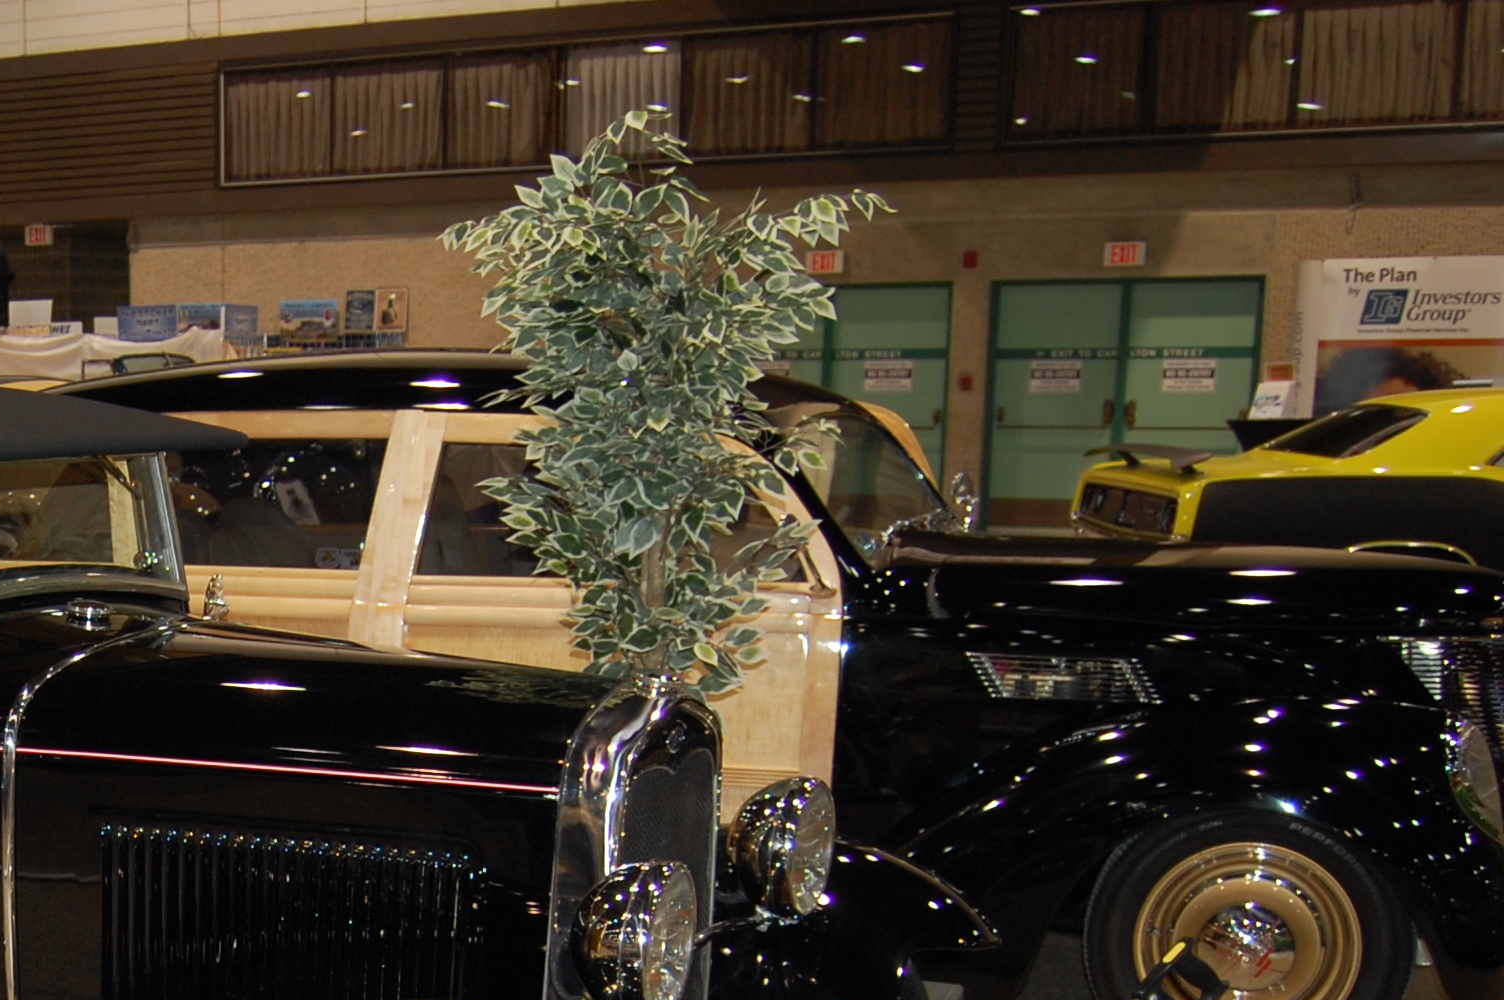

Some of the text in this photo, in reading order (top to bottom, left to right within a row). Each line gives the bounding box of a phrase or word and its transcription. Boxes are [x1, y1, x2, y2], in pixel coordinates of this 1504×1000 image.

[812, 252, 837, 272] EXIT
[1111, 243, 1139, 265] EXIT
[1342, 266, 1417, 283] The Plan
[1348, 287, 1361, 298] by
[1411, 287, 1502, 307] Investors
[1406, 305, 1468, 325] Group
